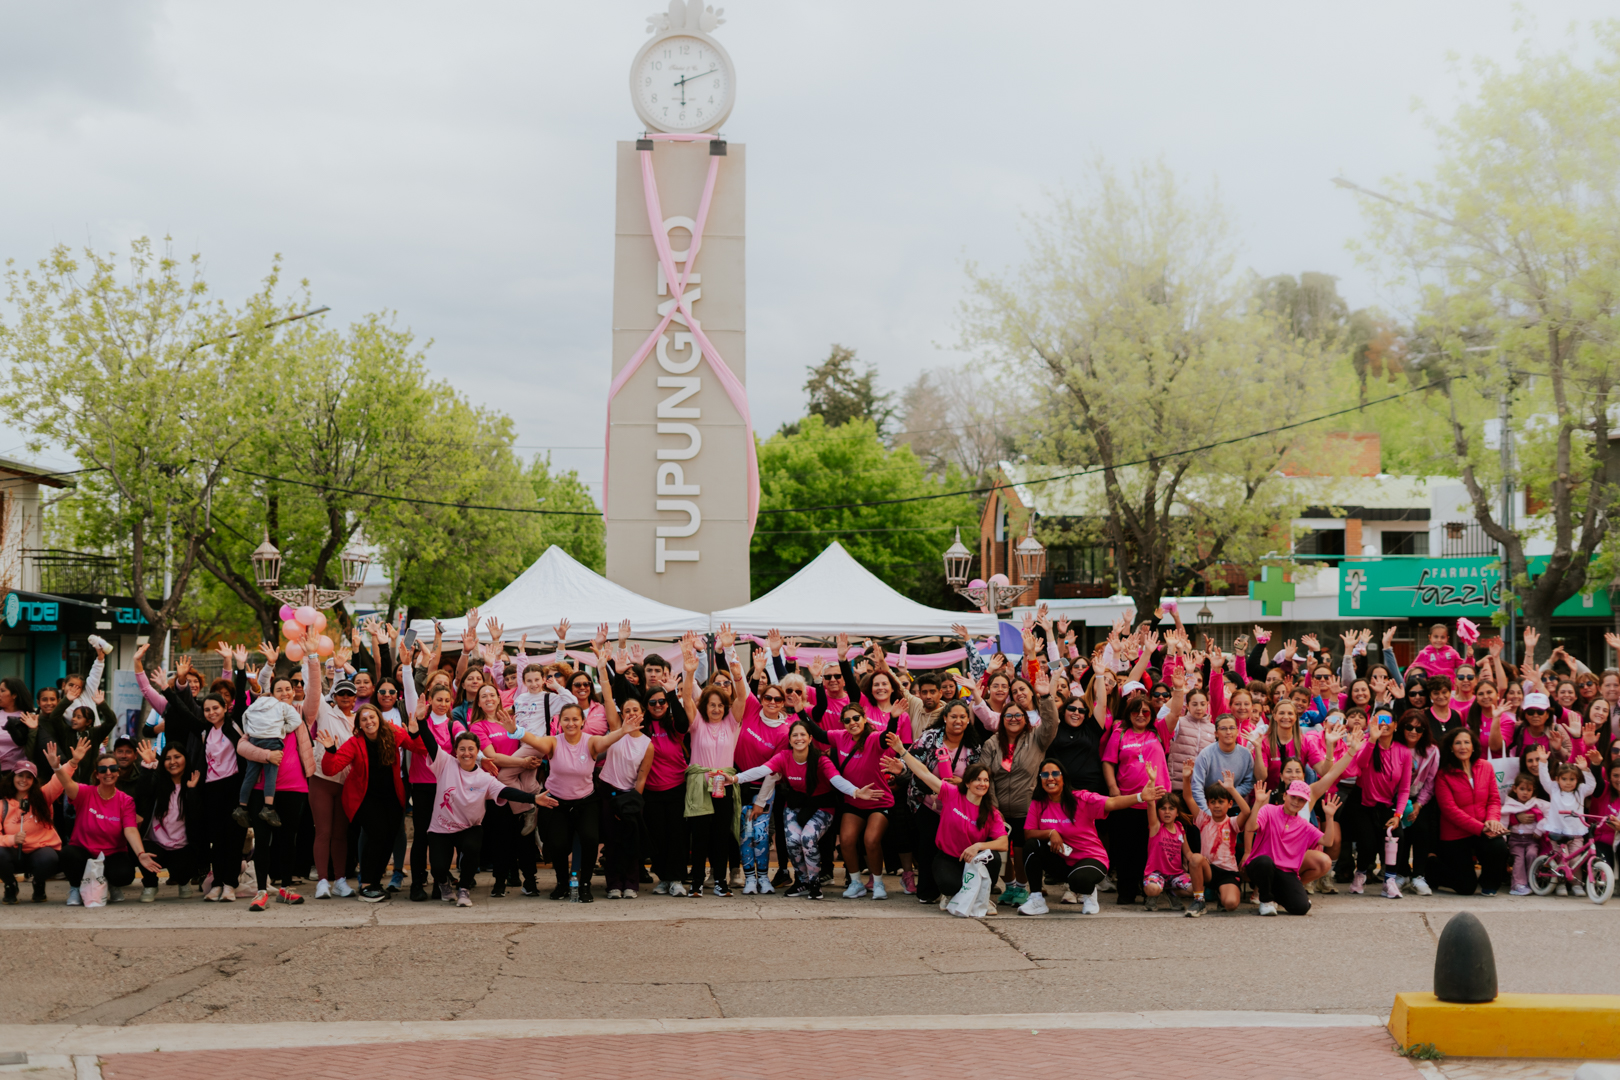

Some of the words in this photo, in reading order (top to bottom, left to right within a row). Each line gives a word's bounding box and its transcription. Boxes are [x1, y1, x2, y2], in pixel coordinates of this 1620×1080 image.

[663, 50, 672, 59] 11
[679, 45, 690, 55] 12
[698, 50, 703, 59] 1
[651, 61, 662, 71] 10
[709, 62, 716, 72] 2
[645, 77, 652, 87] 9
[713, 79, 720, 89] 3
[651, 93, 658, 103] 8
[708, 95, 714, 105] 4
[662, 107, 669, 117] 7
[679, 111, 686, 120] 6
[696, 108, 703, 118] 5
[1432, 567, 1501, 578] FARMACI
